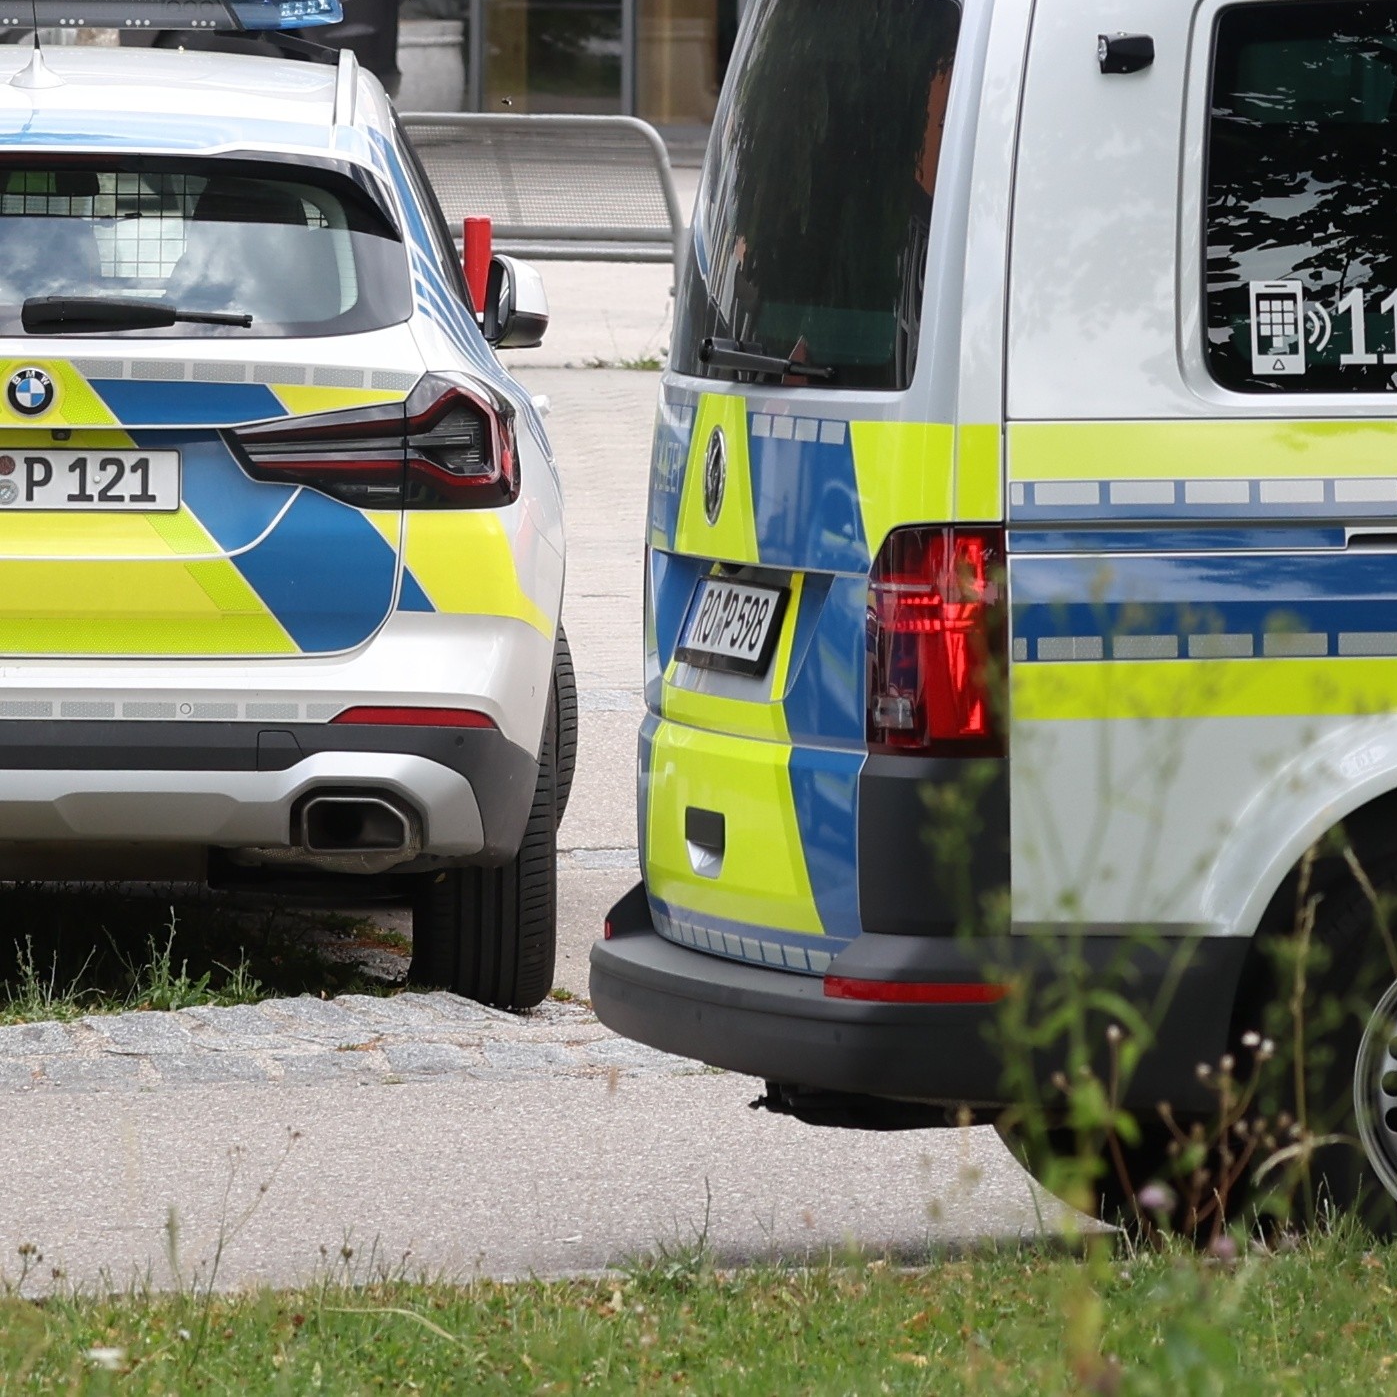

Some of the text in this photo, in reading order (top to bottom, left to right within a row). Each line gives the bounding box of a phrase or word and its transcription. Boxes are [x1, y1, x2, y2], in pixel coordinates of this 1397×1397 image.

[11, 369, 51, 386] BMW
[24, 457, 156, 502] P 121
[692, 589, 770, 653] RO P 598
